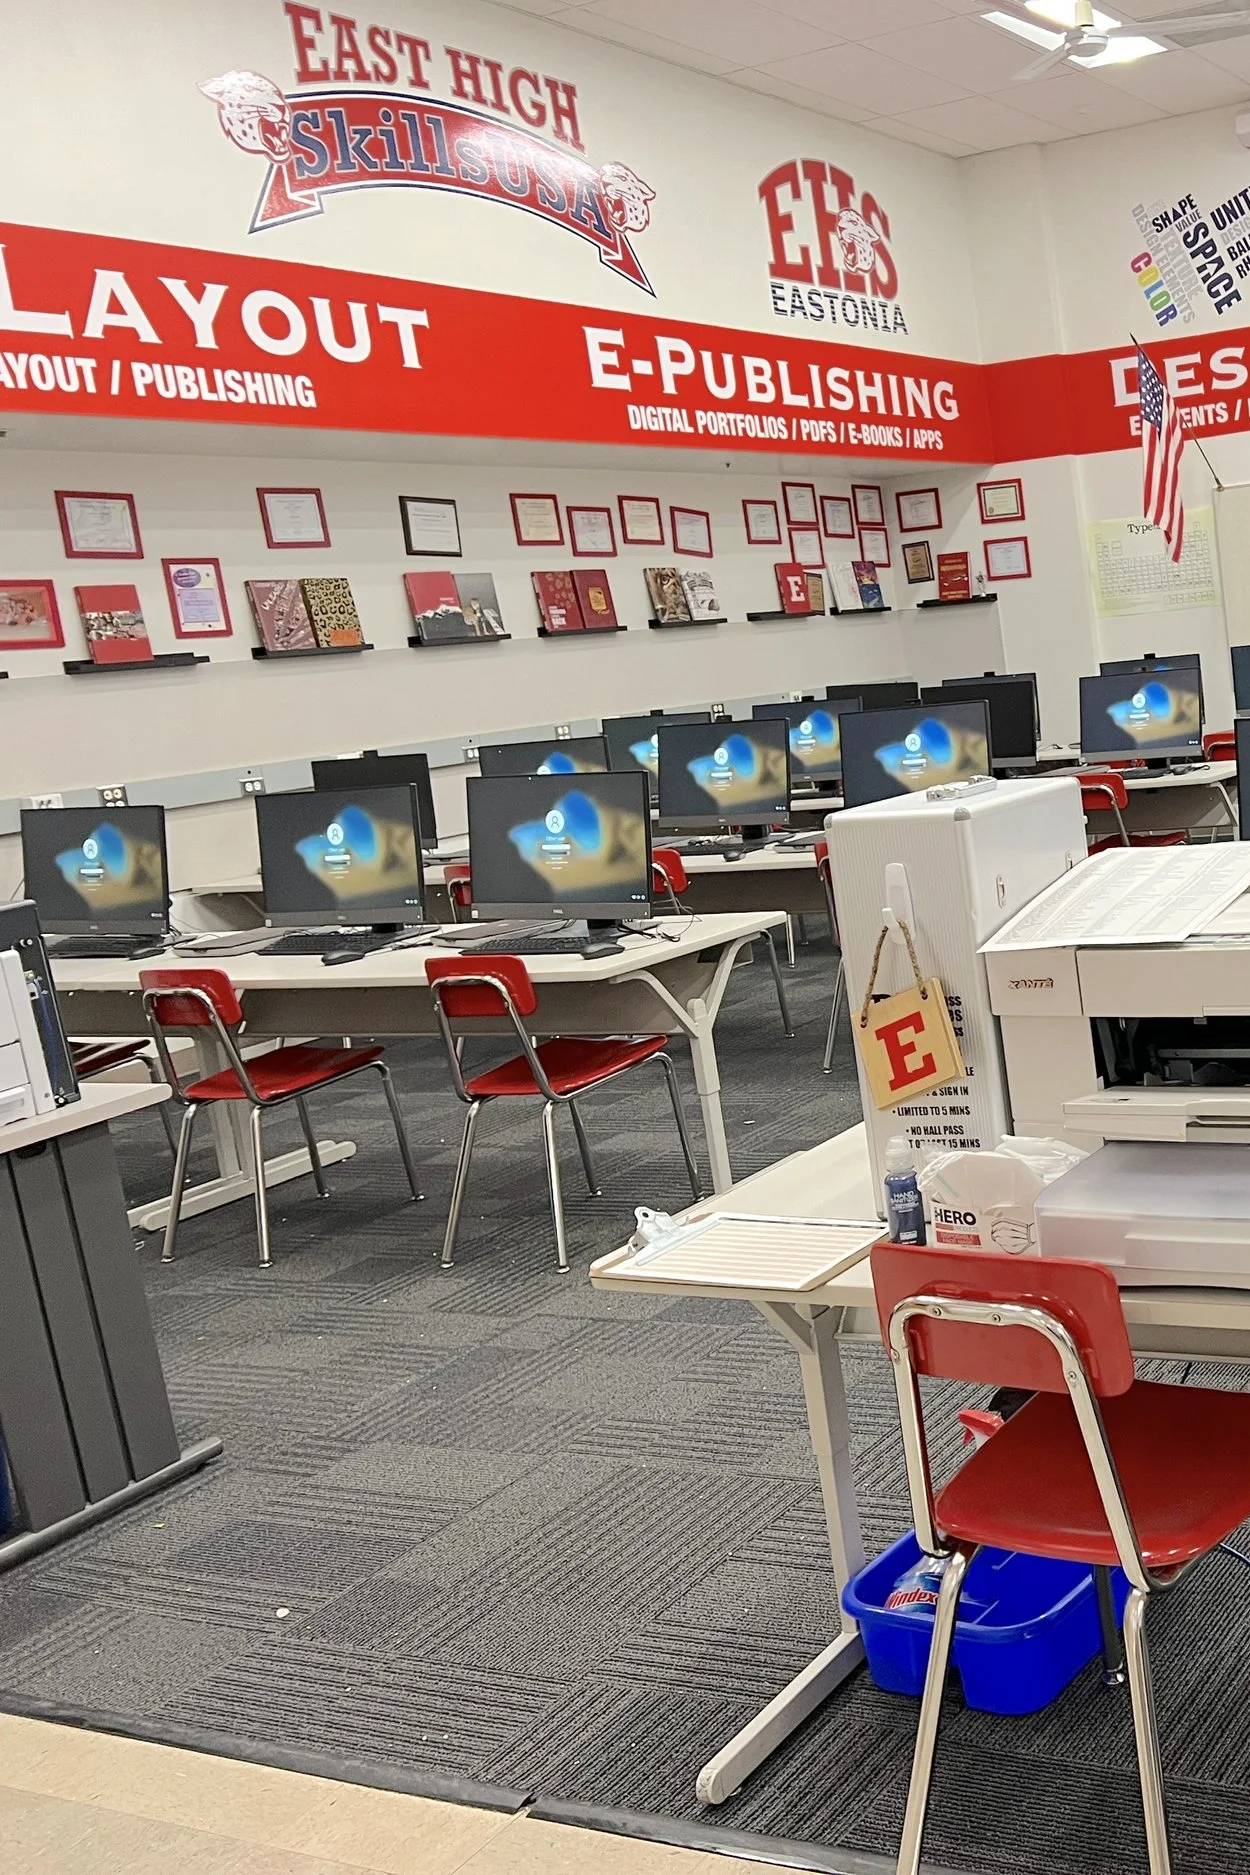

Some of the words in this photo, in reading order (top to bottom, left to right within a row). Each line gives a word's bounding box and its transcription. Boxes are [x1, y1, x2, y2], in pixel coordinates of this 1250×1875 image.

[283, 0, 432, 90] EAST
[444, 46, 586, 155] HIGH
[291, 109, 611, 239] SkillsUSA
[758, 158, 898, 300] EHS
[1175, 209, 1202, 233] VALUE
[1130, 251, 1177, 327] COLOR
[1131, 203, 1163, 257] DESIGN
[1156, 254, 1195, 324] ELEMENTS
[1159, 228, 1204, 300] TEXTURE
[1182, 221, 1242, 315] SPACE
[0, 243, 429, 369] LAYOUT
[769, 281, 909, 335] EASTONIA
[111, 359, 121, 396] /
[133, 363, 317, 408] PUBLISHING
[583, 326, 960, 420] E-PUBLISHING
[627, 405, 694, 433] DIGITAL
[696, 409, 789, 440] PORTFOLIOS
[792, 418, 797, 441] /
[800, 419, 836, 444] PDFS
[840, 423, 845, 444] /
[848, 422, 902, 448] E-BOOKS
[905, 427, 910, 449] /
[913, 429, 944, 451] APPS
[786, 575, 805, 601] E
[875, 1010, 937, 1092] E
[897, 1106, 928, 1117] LIMITED
[930, 1106, 940, 1116] TO
[942, 1106, 948, 1116] 5
[949, 1105, 971, 1116] MINS
[939, 1086, 959, 1096] SIGN
[960, 1086, 969, 1096] IN
[911, 1125, 921, 1136] NO
[923, 1125, 942, 1136] HALL
[943, 1124, 965, 1136] PASS
[948, 1138, 958, 1149] 15
[959, 1138, 981, 1149] MINS
[935, 1206, 977, 1226] HERO
